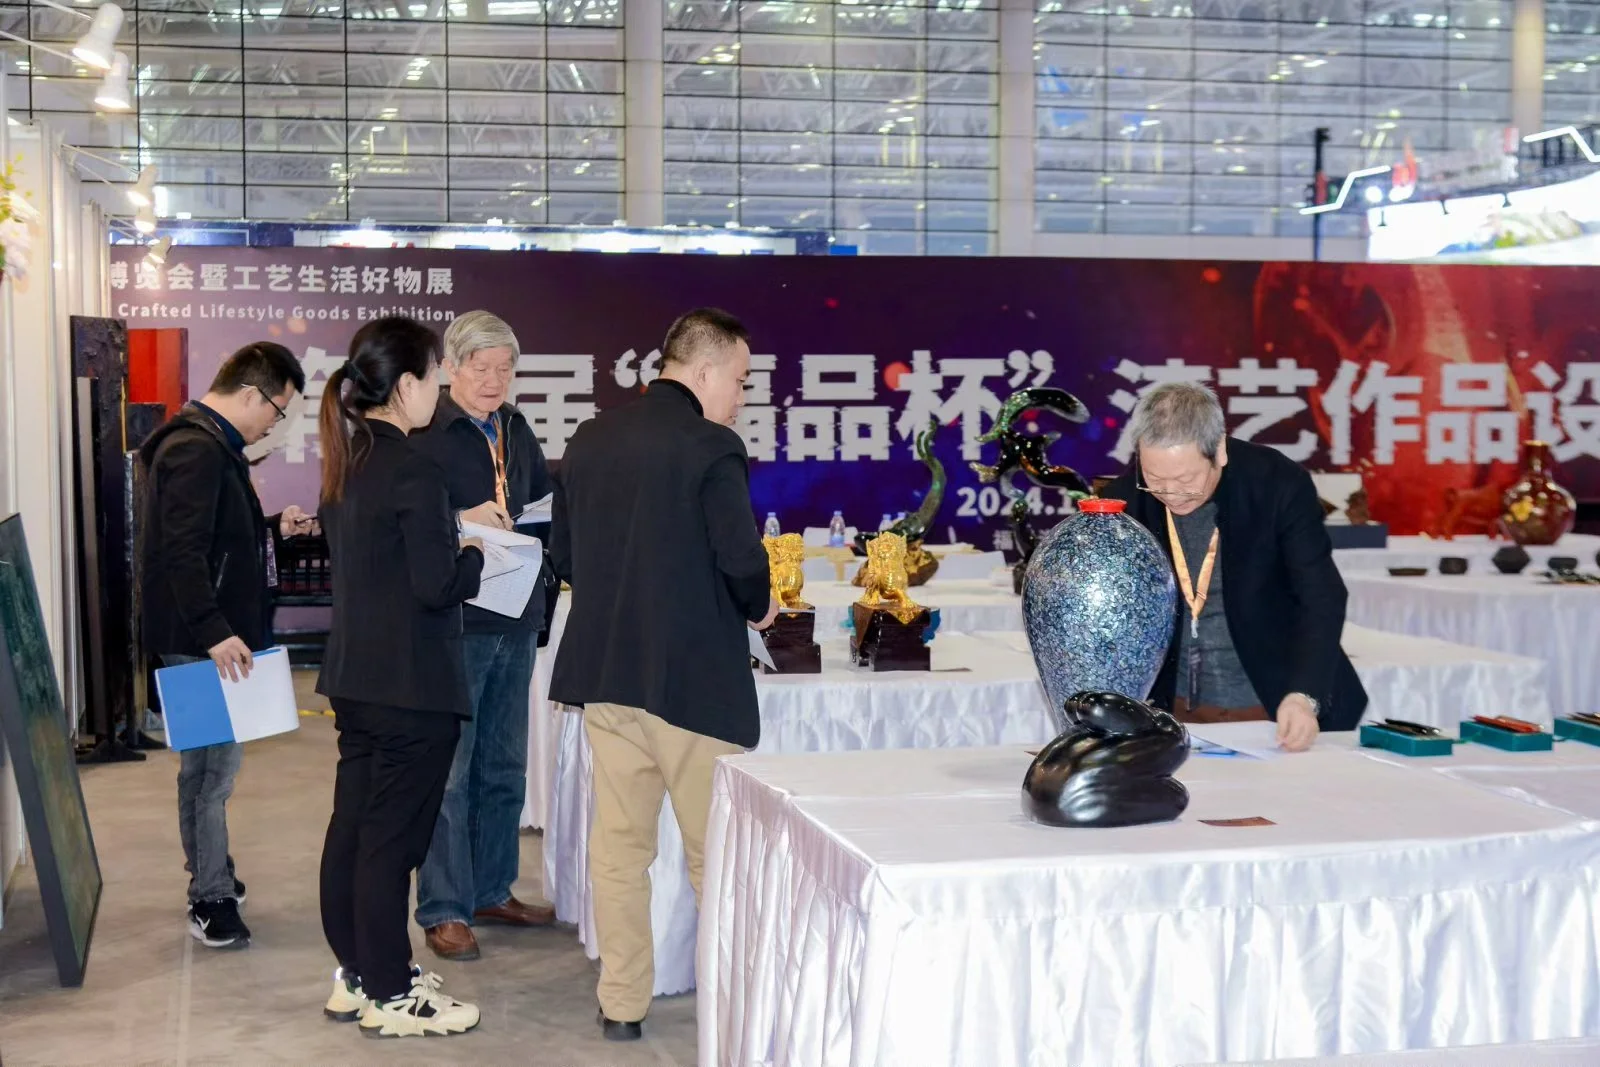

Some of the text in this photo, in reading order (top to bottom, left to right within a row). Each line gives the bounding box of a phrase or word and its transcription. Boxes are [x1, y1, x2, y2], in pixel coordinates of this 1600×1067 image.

[117, 302, 192, 319] Crafted
[199, 304, 285, 322] Lifestyle
[292, 305, 351, 320] Goods
